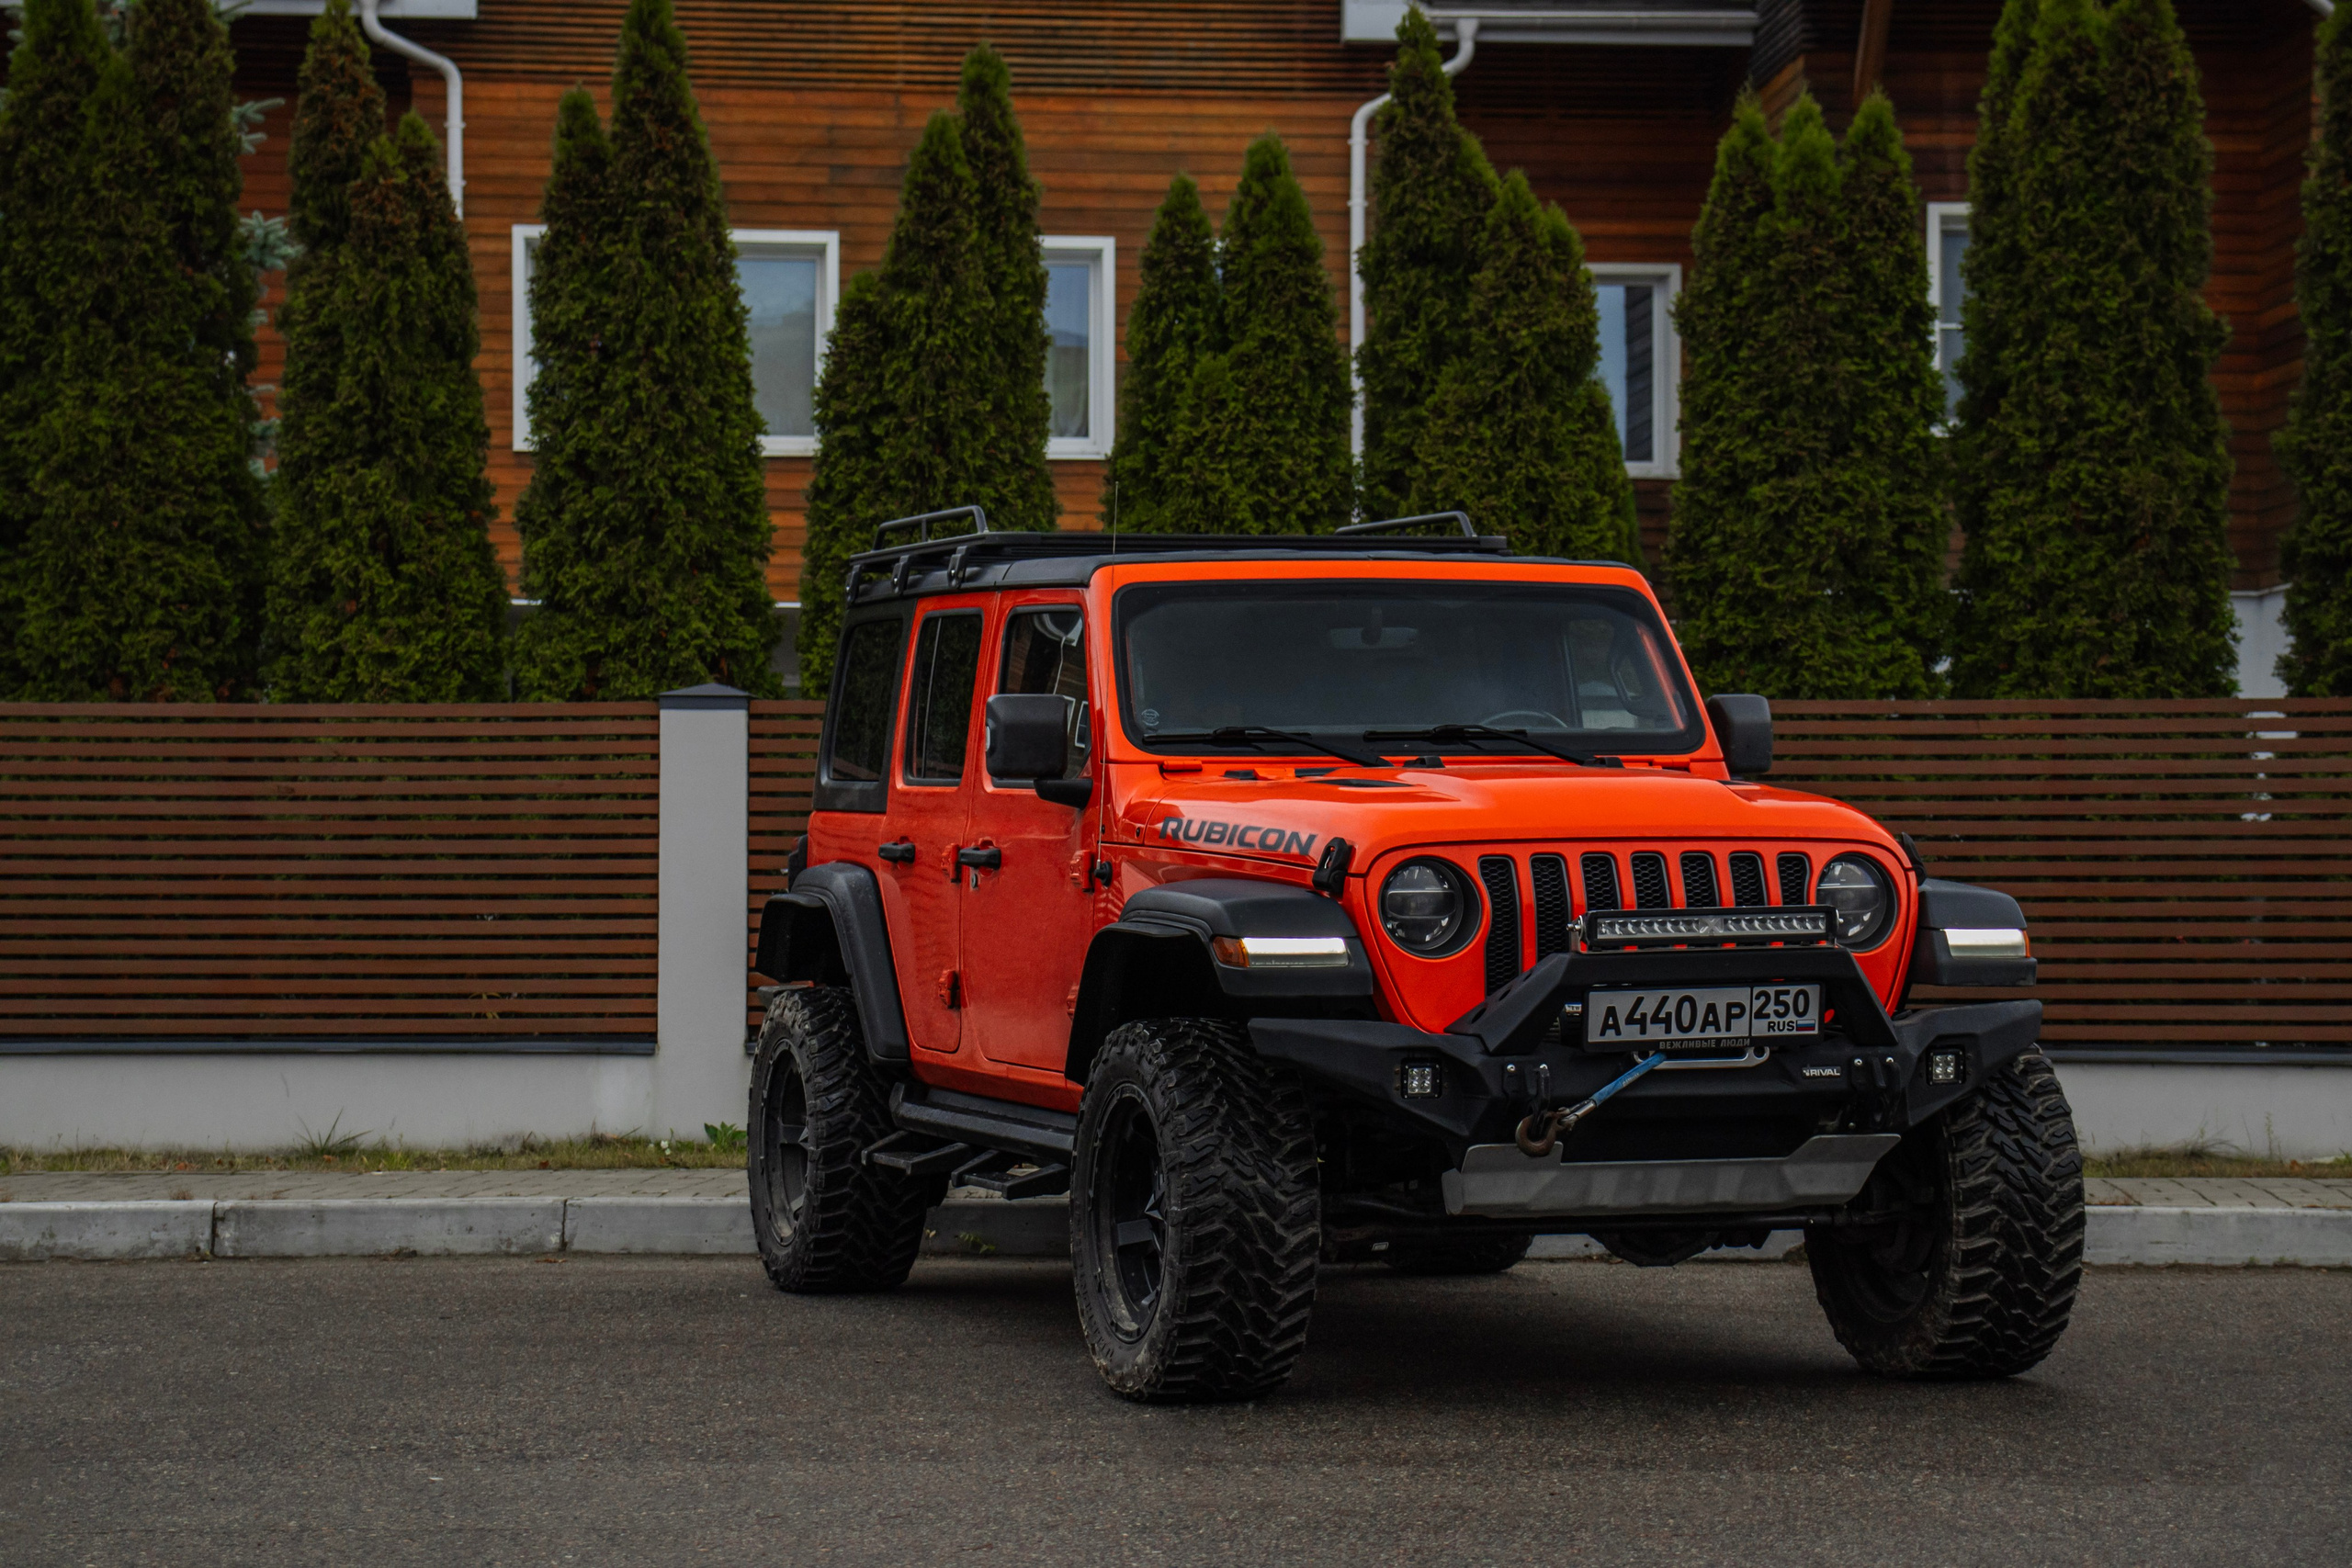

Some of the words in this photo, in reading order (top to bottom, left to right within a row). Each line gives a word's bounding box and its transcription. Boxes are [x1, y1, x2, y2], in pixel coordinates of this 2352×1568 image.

[1159, 817, 1318, 855] RUBICON
[1753, 988, 1810, 1020] 250
[1767, 1020, 1795, 1032] RUS
[1659, 1039, 1716, 1049] ВЕЖЛИВЫЕ
[1720, 1038, 1750, 1047] ЛЮДИ
[1810, 1068, 1840, 1077] RIVAL
